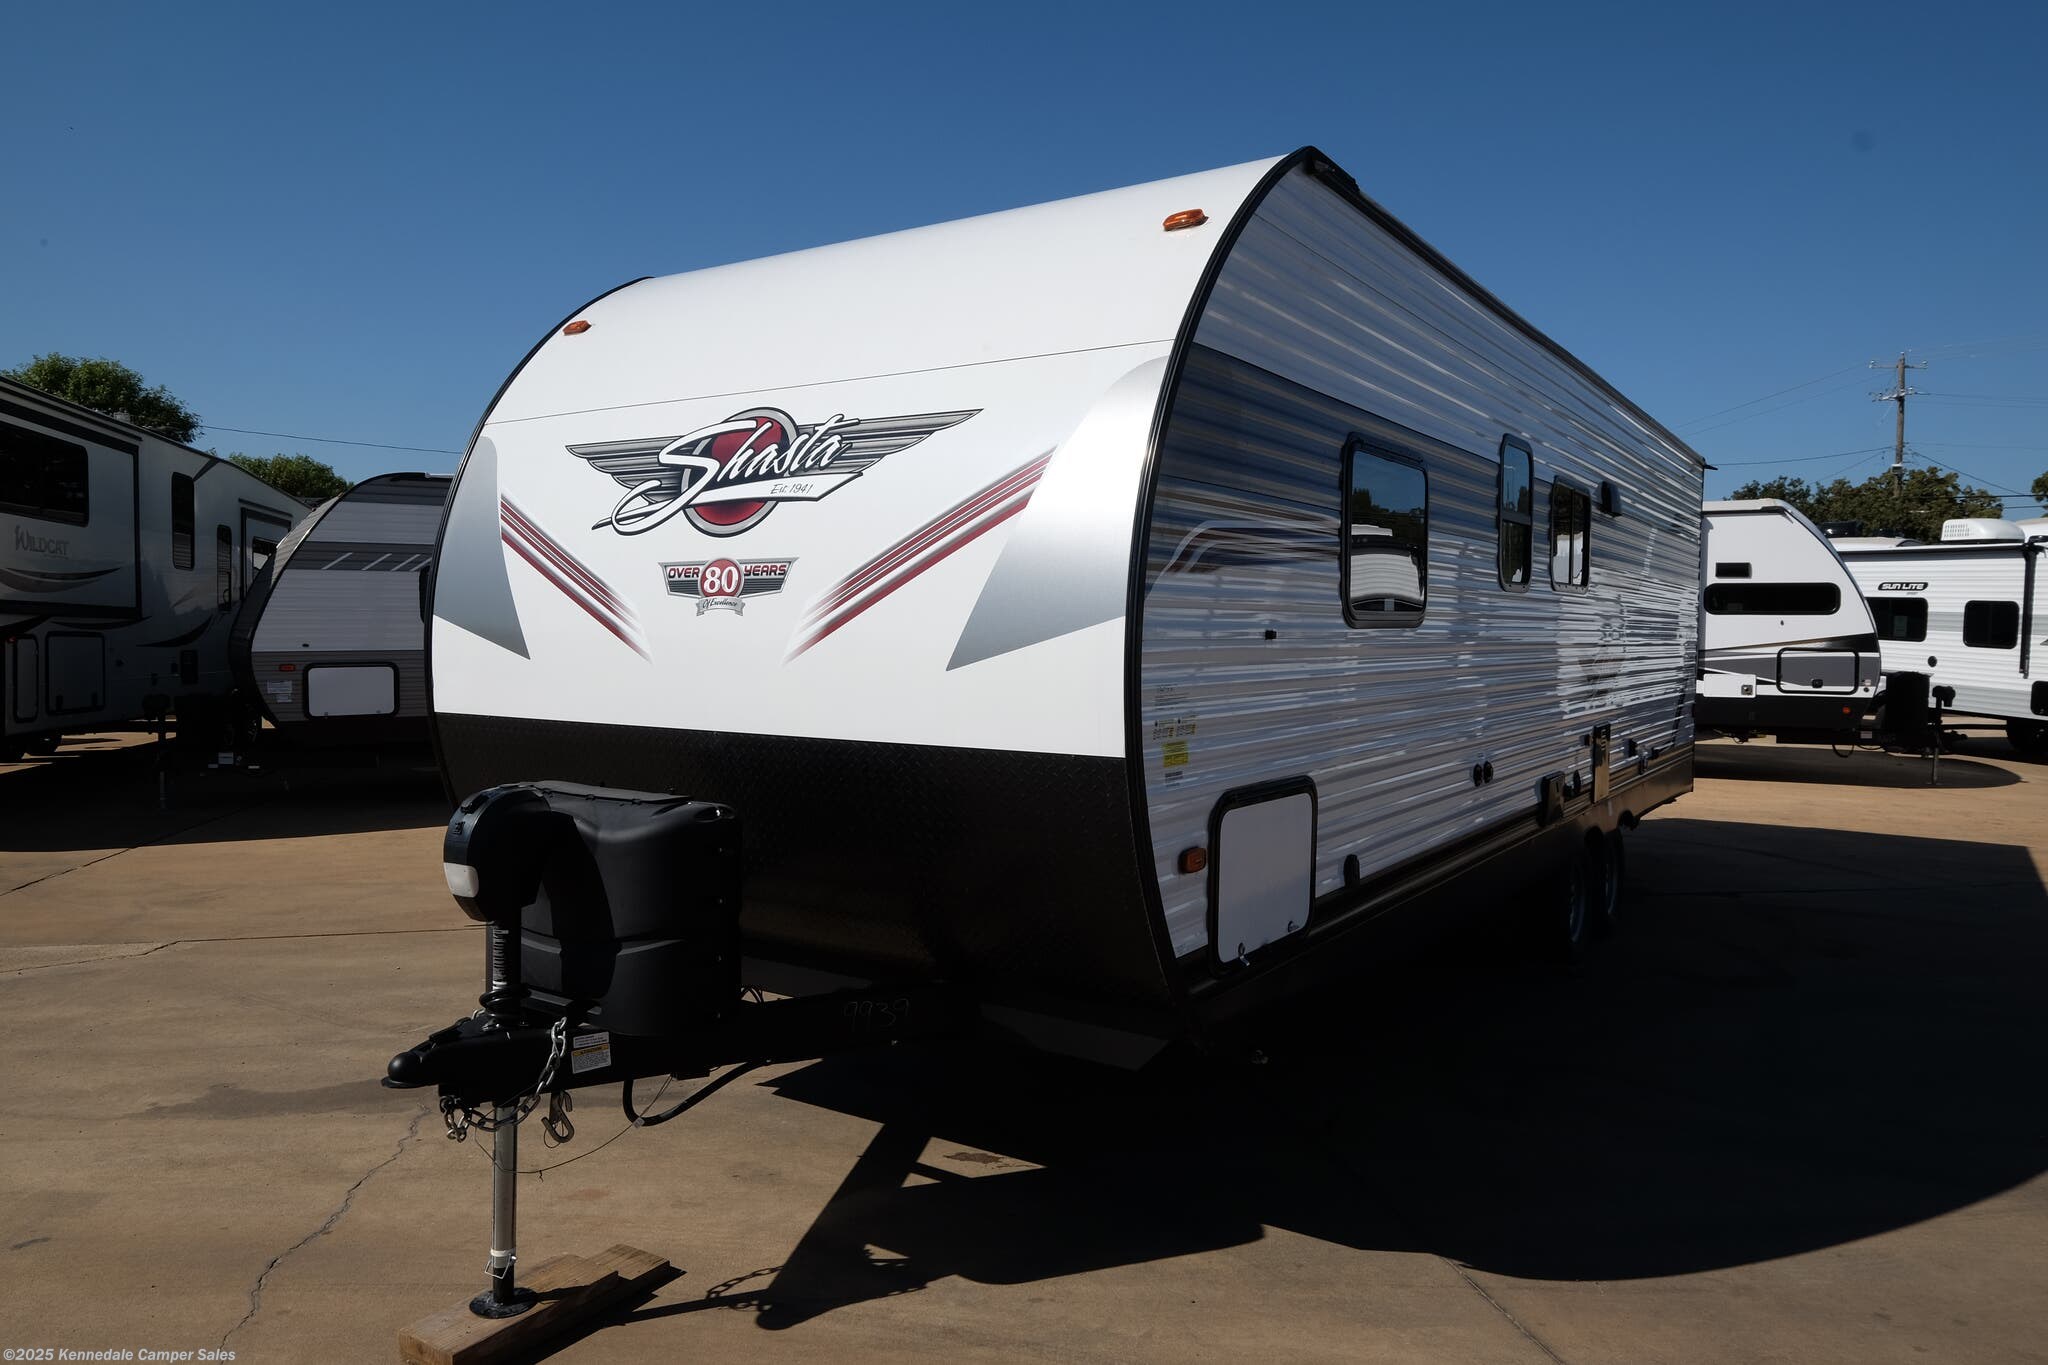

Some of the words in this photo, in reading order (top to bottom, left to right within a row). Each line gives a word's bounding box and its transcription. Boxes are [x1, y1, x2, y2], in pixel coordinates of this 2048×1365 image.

[610, 413, 861, 536] Shasta
[790, 483, 813, 494] 1941
[668, 567, 700, 578] OVER
[703, 566, 739, 593] 80
[744, 564, 787, 576] YEARS
